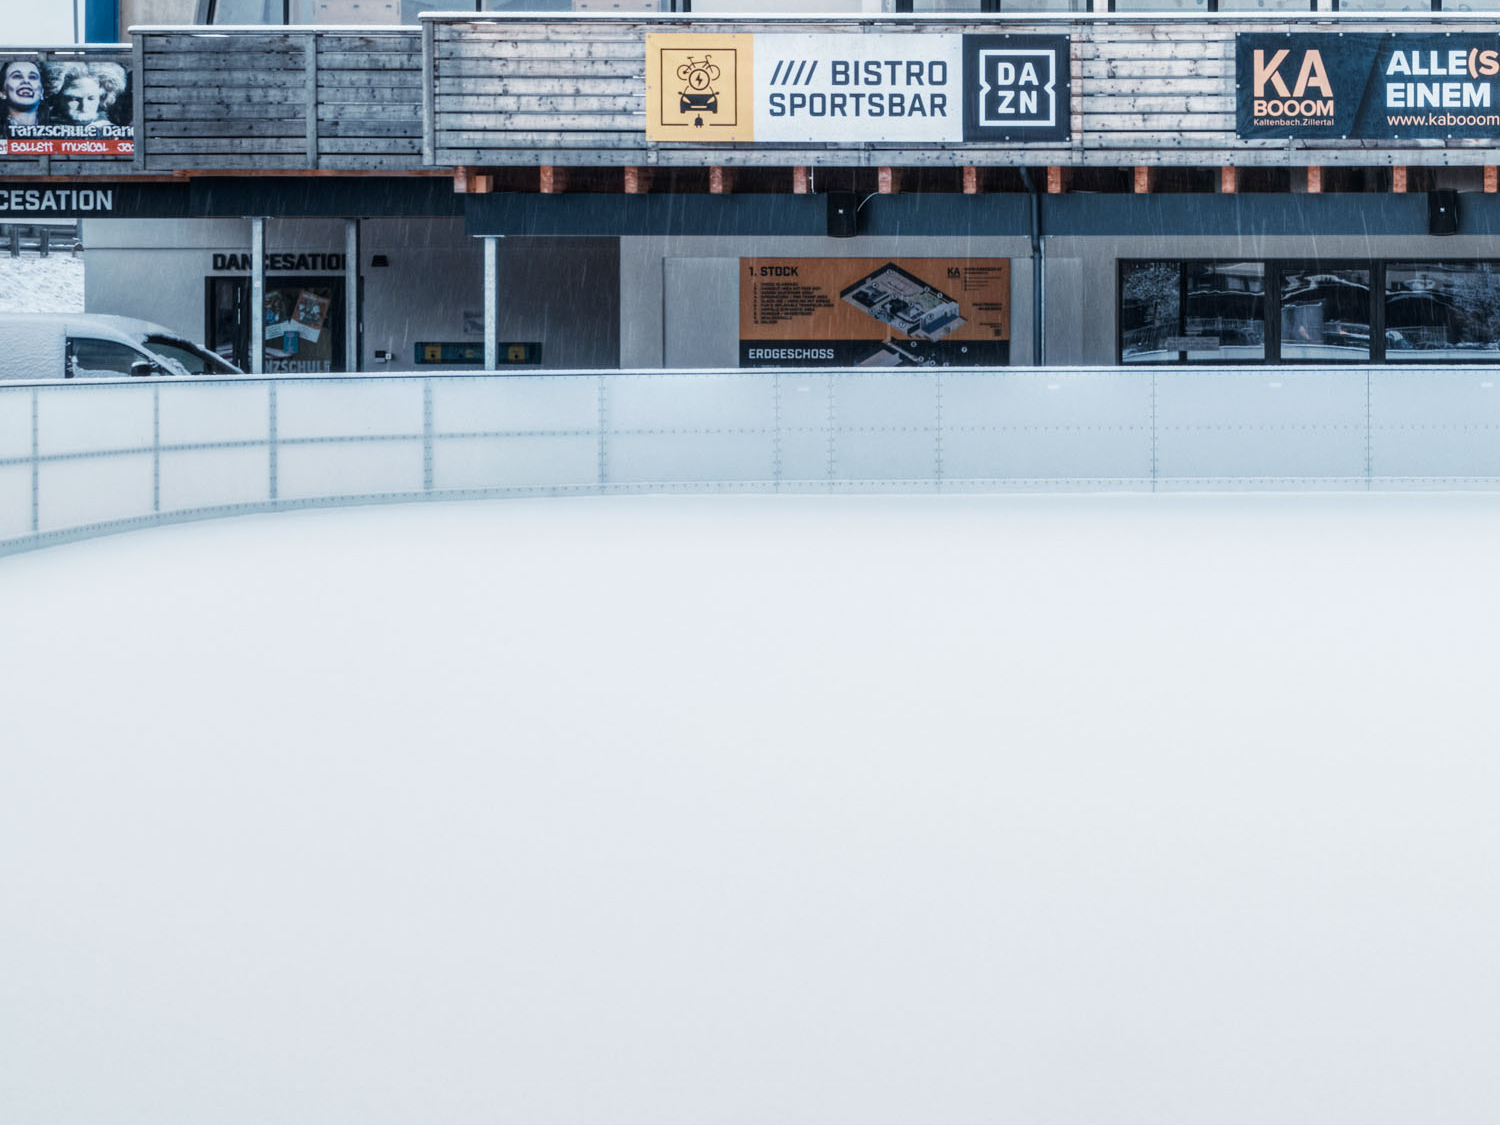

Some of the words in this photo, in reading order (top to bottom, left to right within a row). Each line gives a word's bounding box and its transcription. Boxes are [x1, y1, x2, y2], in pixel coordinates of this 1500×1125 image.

[831, 60, 948, 86] BISTRO
[1253, 49, 1334, 98] KA
[1386, 82, 1491, 108] EINEM
[769, 93, 948, 118] SPORTSBAR
[1253, 99, 1334, 117] BOOOM
[102, 125, 134, 137] Dan
[1253, 118, 1334, 126] Kaltenbach.Zillertal
[0, 190, 113, 211] CESATION
[760, 267, 799, 277] STOCK
[947, 267, 960, 276] KA
[748, 348, 835, 359] ERDGESCHOSS
